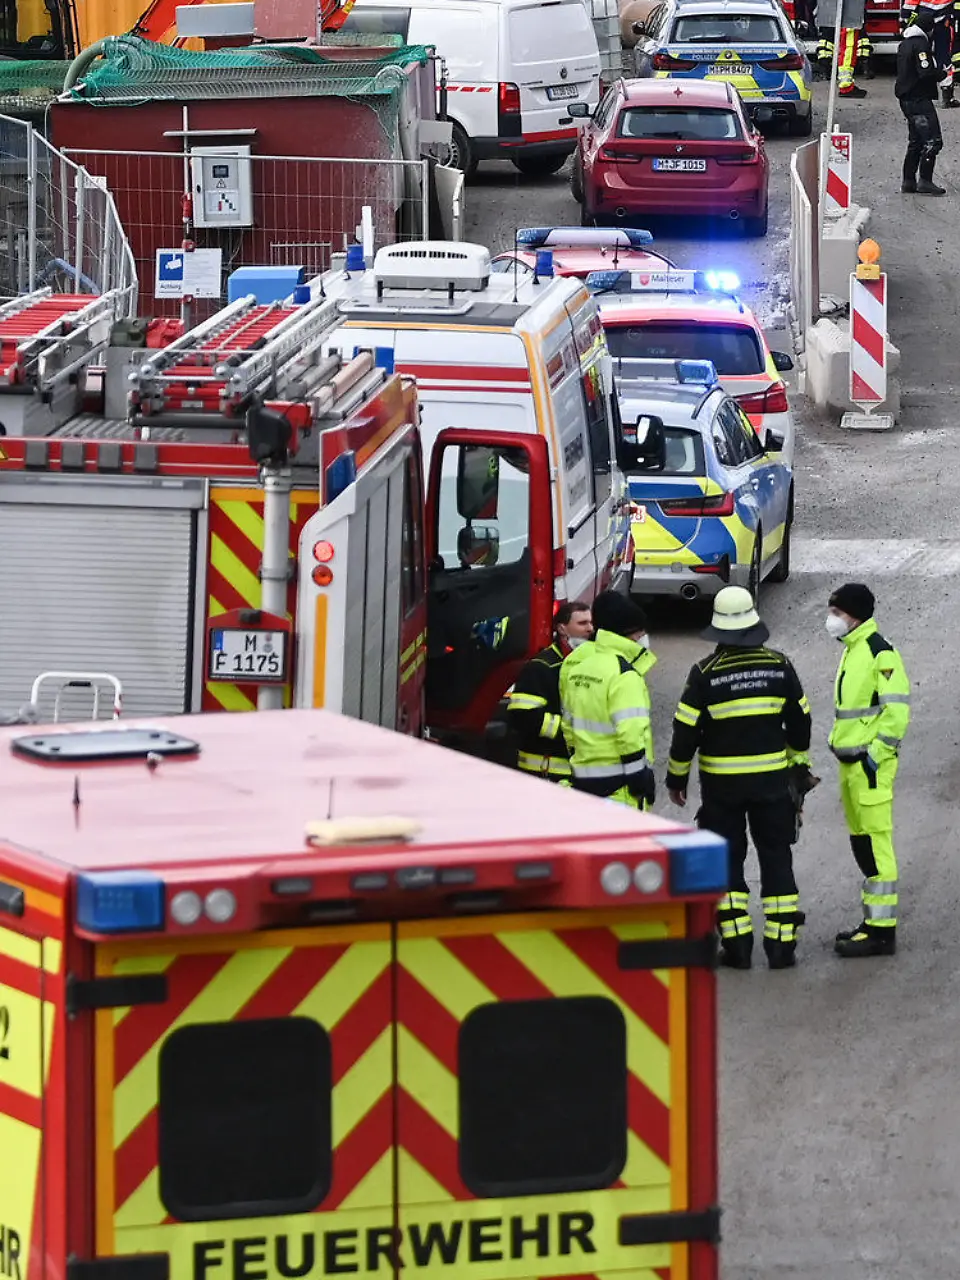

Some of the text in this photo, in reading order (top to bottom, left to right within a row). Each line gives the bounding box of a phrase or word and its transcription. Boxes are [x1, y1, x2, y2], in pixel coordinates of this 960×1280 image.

[682, 160, 705, 169] 1015
[245, 634, 257, 652] M
[215, 651, 280, 673] F 1175
[192, 1211, 597, 1280] FEUERWEHR
